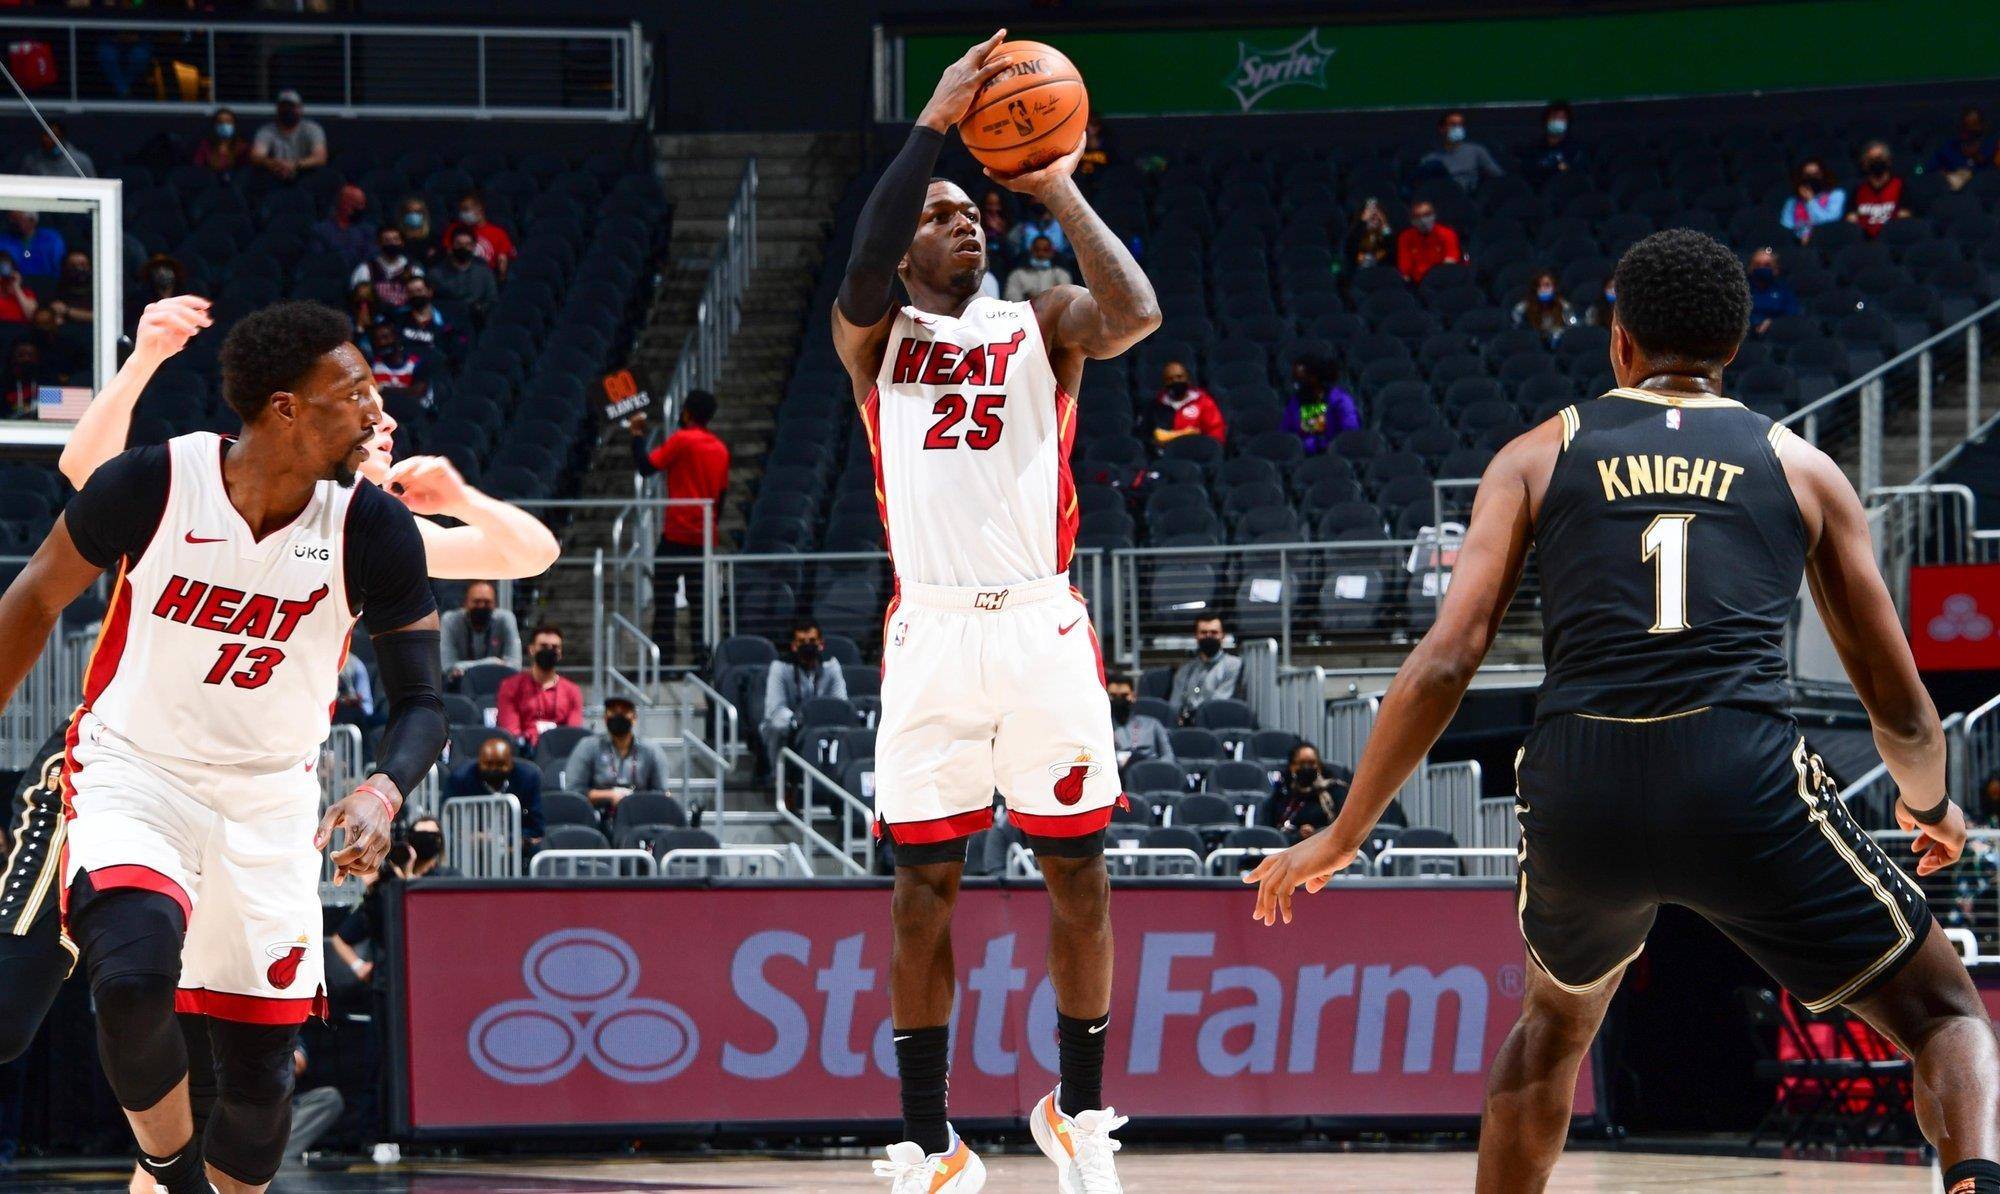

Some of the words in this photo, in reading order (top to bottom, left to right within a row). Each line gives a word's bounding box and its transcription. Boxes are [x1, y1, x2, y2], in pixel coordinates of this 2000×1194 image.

[1237, 49, 1323, 89] Sprite
[892, 328, 1026, 386] HEAT
[923, 393, 1006, 450] 25
[1597, 454, 1745, 502] KNIGHT
[1641, 513, 1696, 634] 1
[152, 574, 330, 643] HEAT
[203, 643, 286, 690] 13
